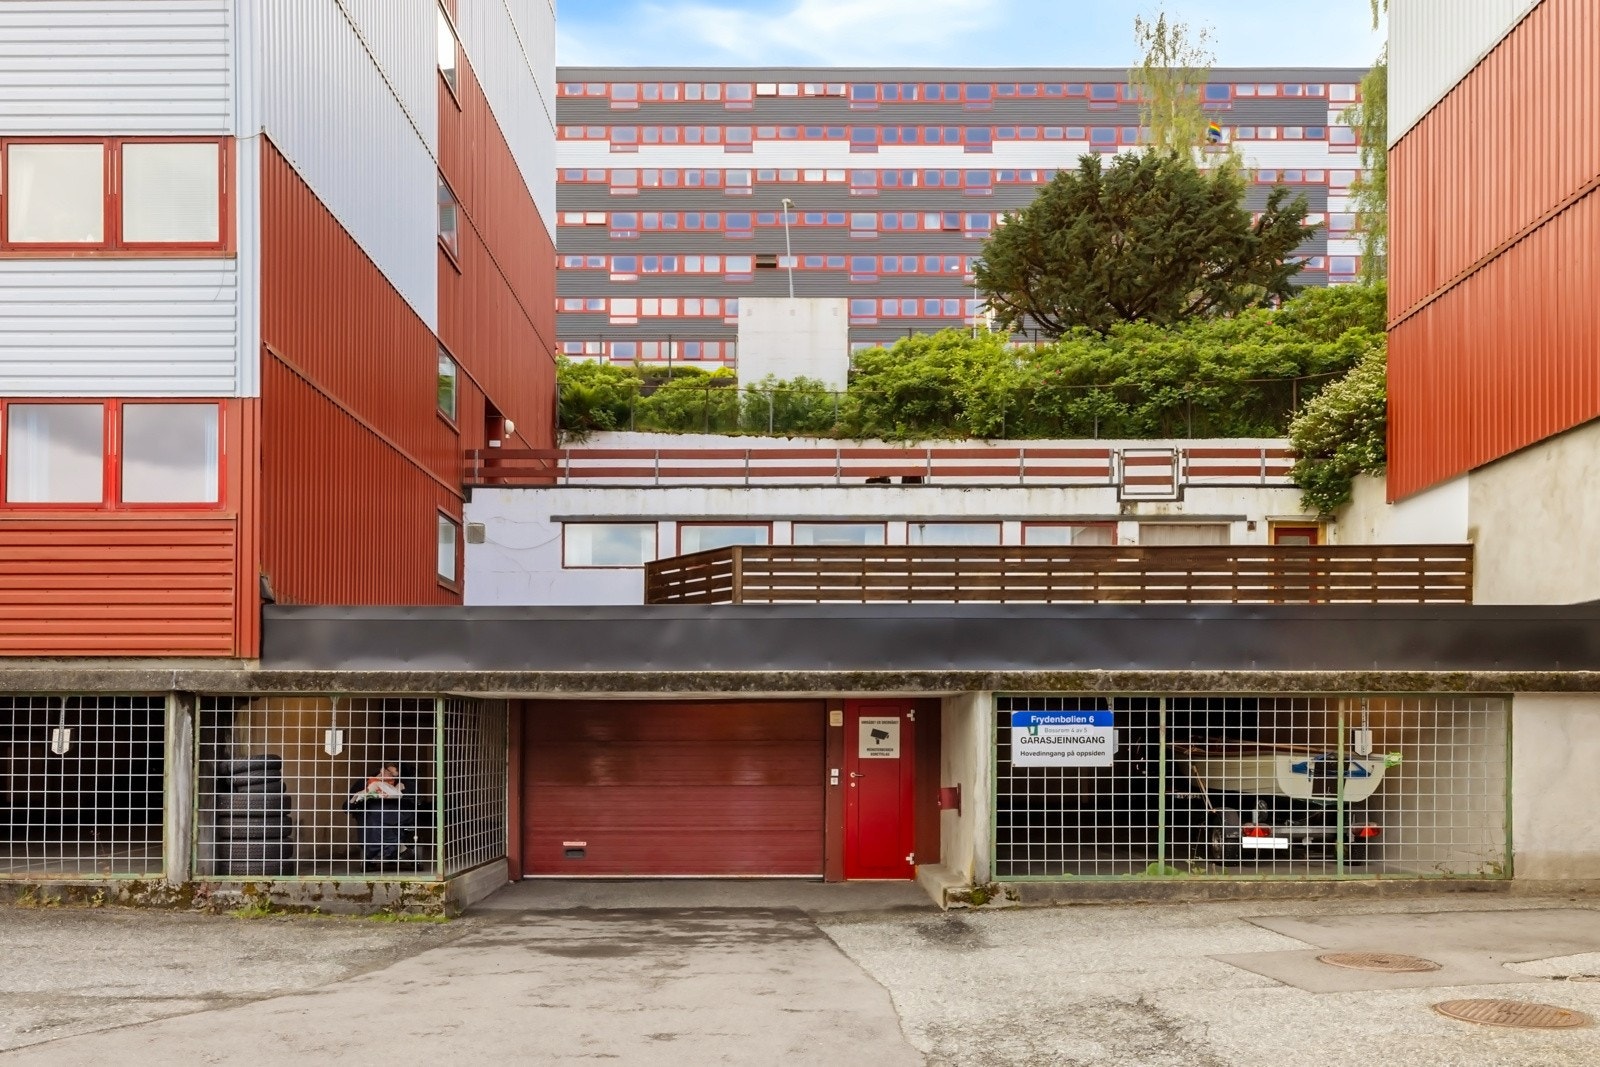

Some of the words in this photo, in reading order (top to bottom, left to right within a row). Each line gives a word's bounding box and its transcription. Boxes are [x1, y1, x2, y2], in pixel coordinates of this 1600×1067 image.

[1031, 715, 1087, 724] Frydenbølien
[1089, 715, 1095, 723] 6
[1020, 736, 1105, 744] GARASJEINNGANG
